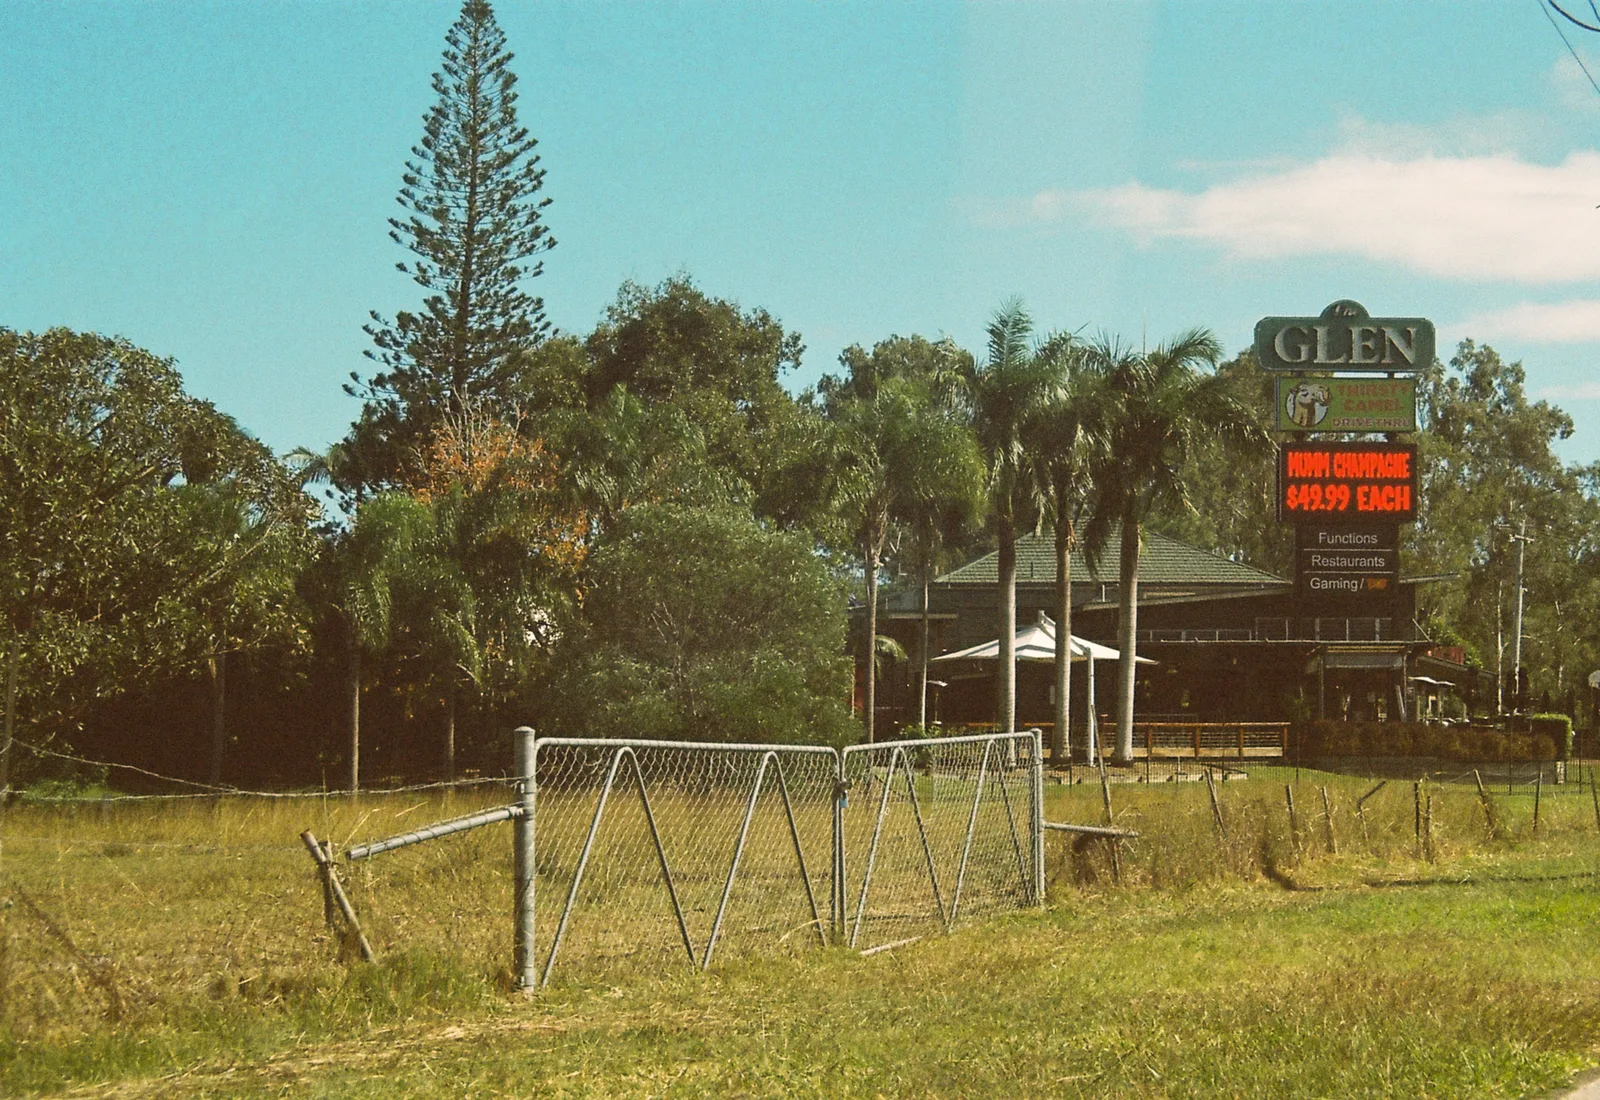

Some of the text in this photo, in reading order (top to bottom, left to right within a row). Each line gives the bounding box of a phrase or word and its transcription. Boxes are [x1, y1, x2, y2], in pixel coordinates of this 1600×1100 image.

[1274, 324, 1419, 365] GLEN
[1336, 382, 1409, 396] THIRSTY
[1343, 398, 1404, 412] CAMEL
[1331, 417, 1373, 428] DRIVE
[1287, 451, 1410, 478] MUMM CHAMPAGNE
[1286, 484, 1410, 511] $49.99 EACH
[1318, 532, 1378, 544] Functions
[1311, 555, 1385, 567] Restaurants
